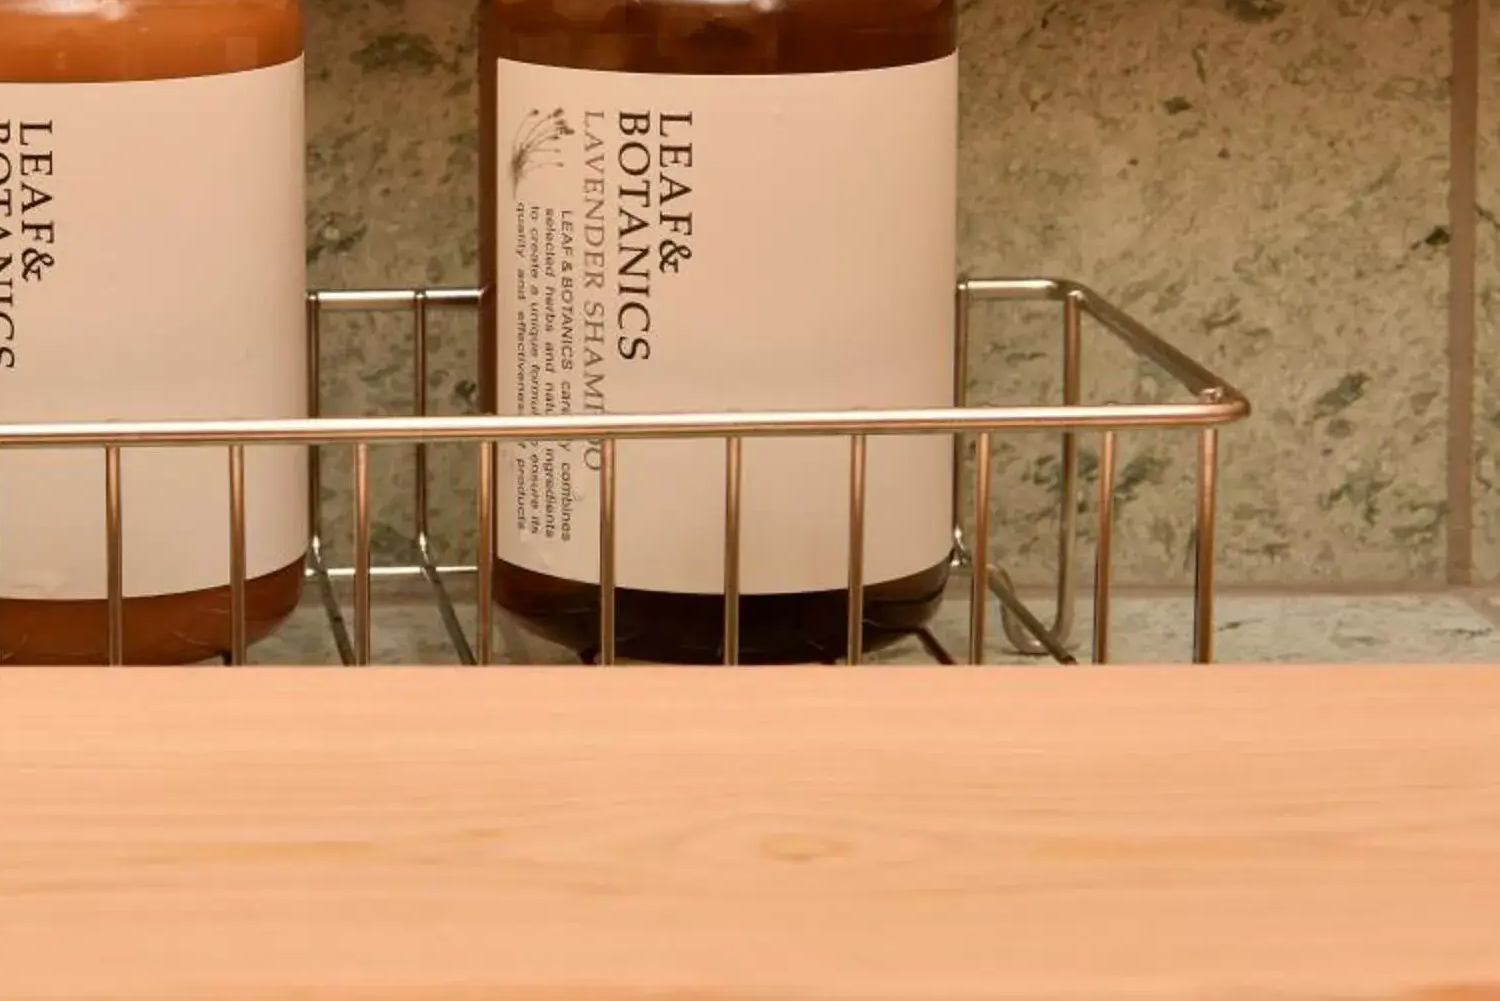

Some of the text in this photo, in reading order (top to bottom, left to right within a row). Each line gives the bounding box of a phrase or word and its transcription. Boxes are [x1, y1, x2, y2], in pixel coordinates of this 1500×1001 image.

[20, 120, 54, 281] LEAF&
[530, 207, 539, 219] to
[584, 111, 604, 289] LAVENDER
[660, 111, 692, 274] LEAF&
[516, 203, 525, 258] quality
[530, 228, 540, 278] create
[545, 208, 555, 277] selected
[561, 211, 572, 256] LEAF
[618, 111, 650, 360] BOTANICS
[518, 269, 526, 299] and
[562, 261, 572, 271] &
[529, 303, 539, 357] unique
[545, 286, 555, 331] herbs
[561, 277, 573, 370] BOTANICS
[545, 343, 555, 372] and
[531, 455, 539, 509] ensure
[544, 449, 555, 538] ingredients
[562, 463, 573, 541] combines
